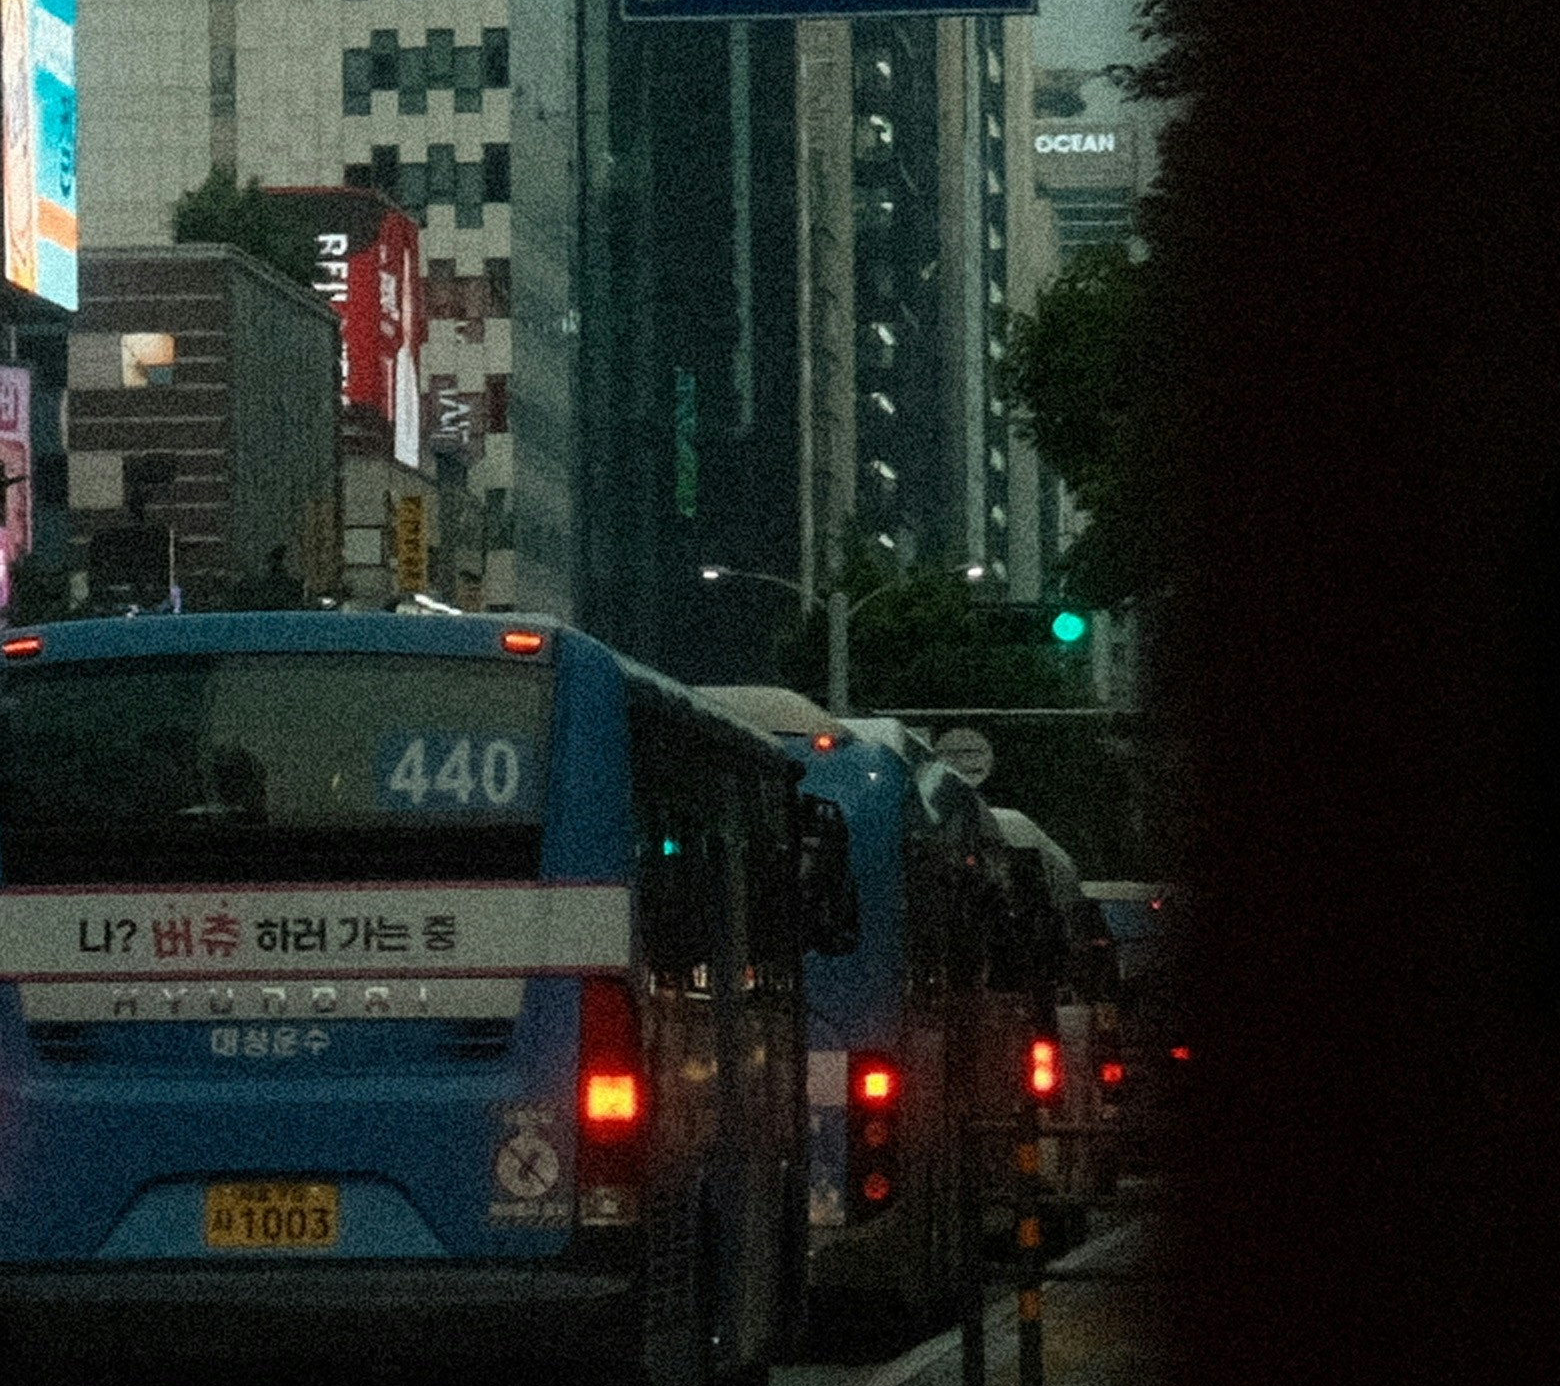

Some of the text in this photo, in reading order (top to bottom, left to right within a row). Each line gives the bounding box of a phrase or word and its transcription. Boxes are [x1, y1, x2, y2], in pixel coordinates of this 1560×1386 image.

[1034, 132, 1116, 154] OCEAN
[389, 736, 520, 805] 440
[79, 919, 137, 954] 나?
[255, 915, 328, 954] 하러
[338, 914, 410, 953] 가는
[422, 914, 456, 952] 중
